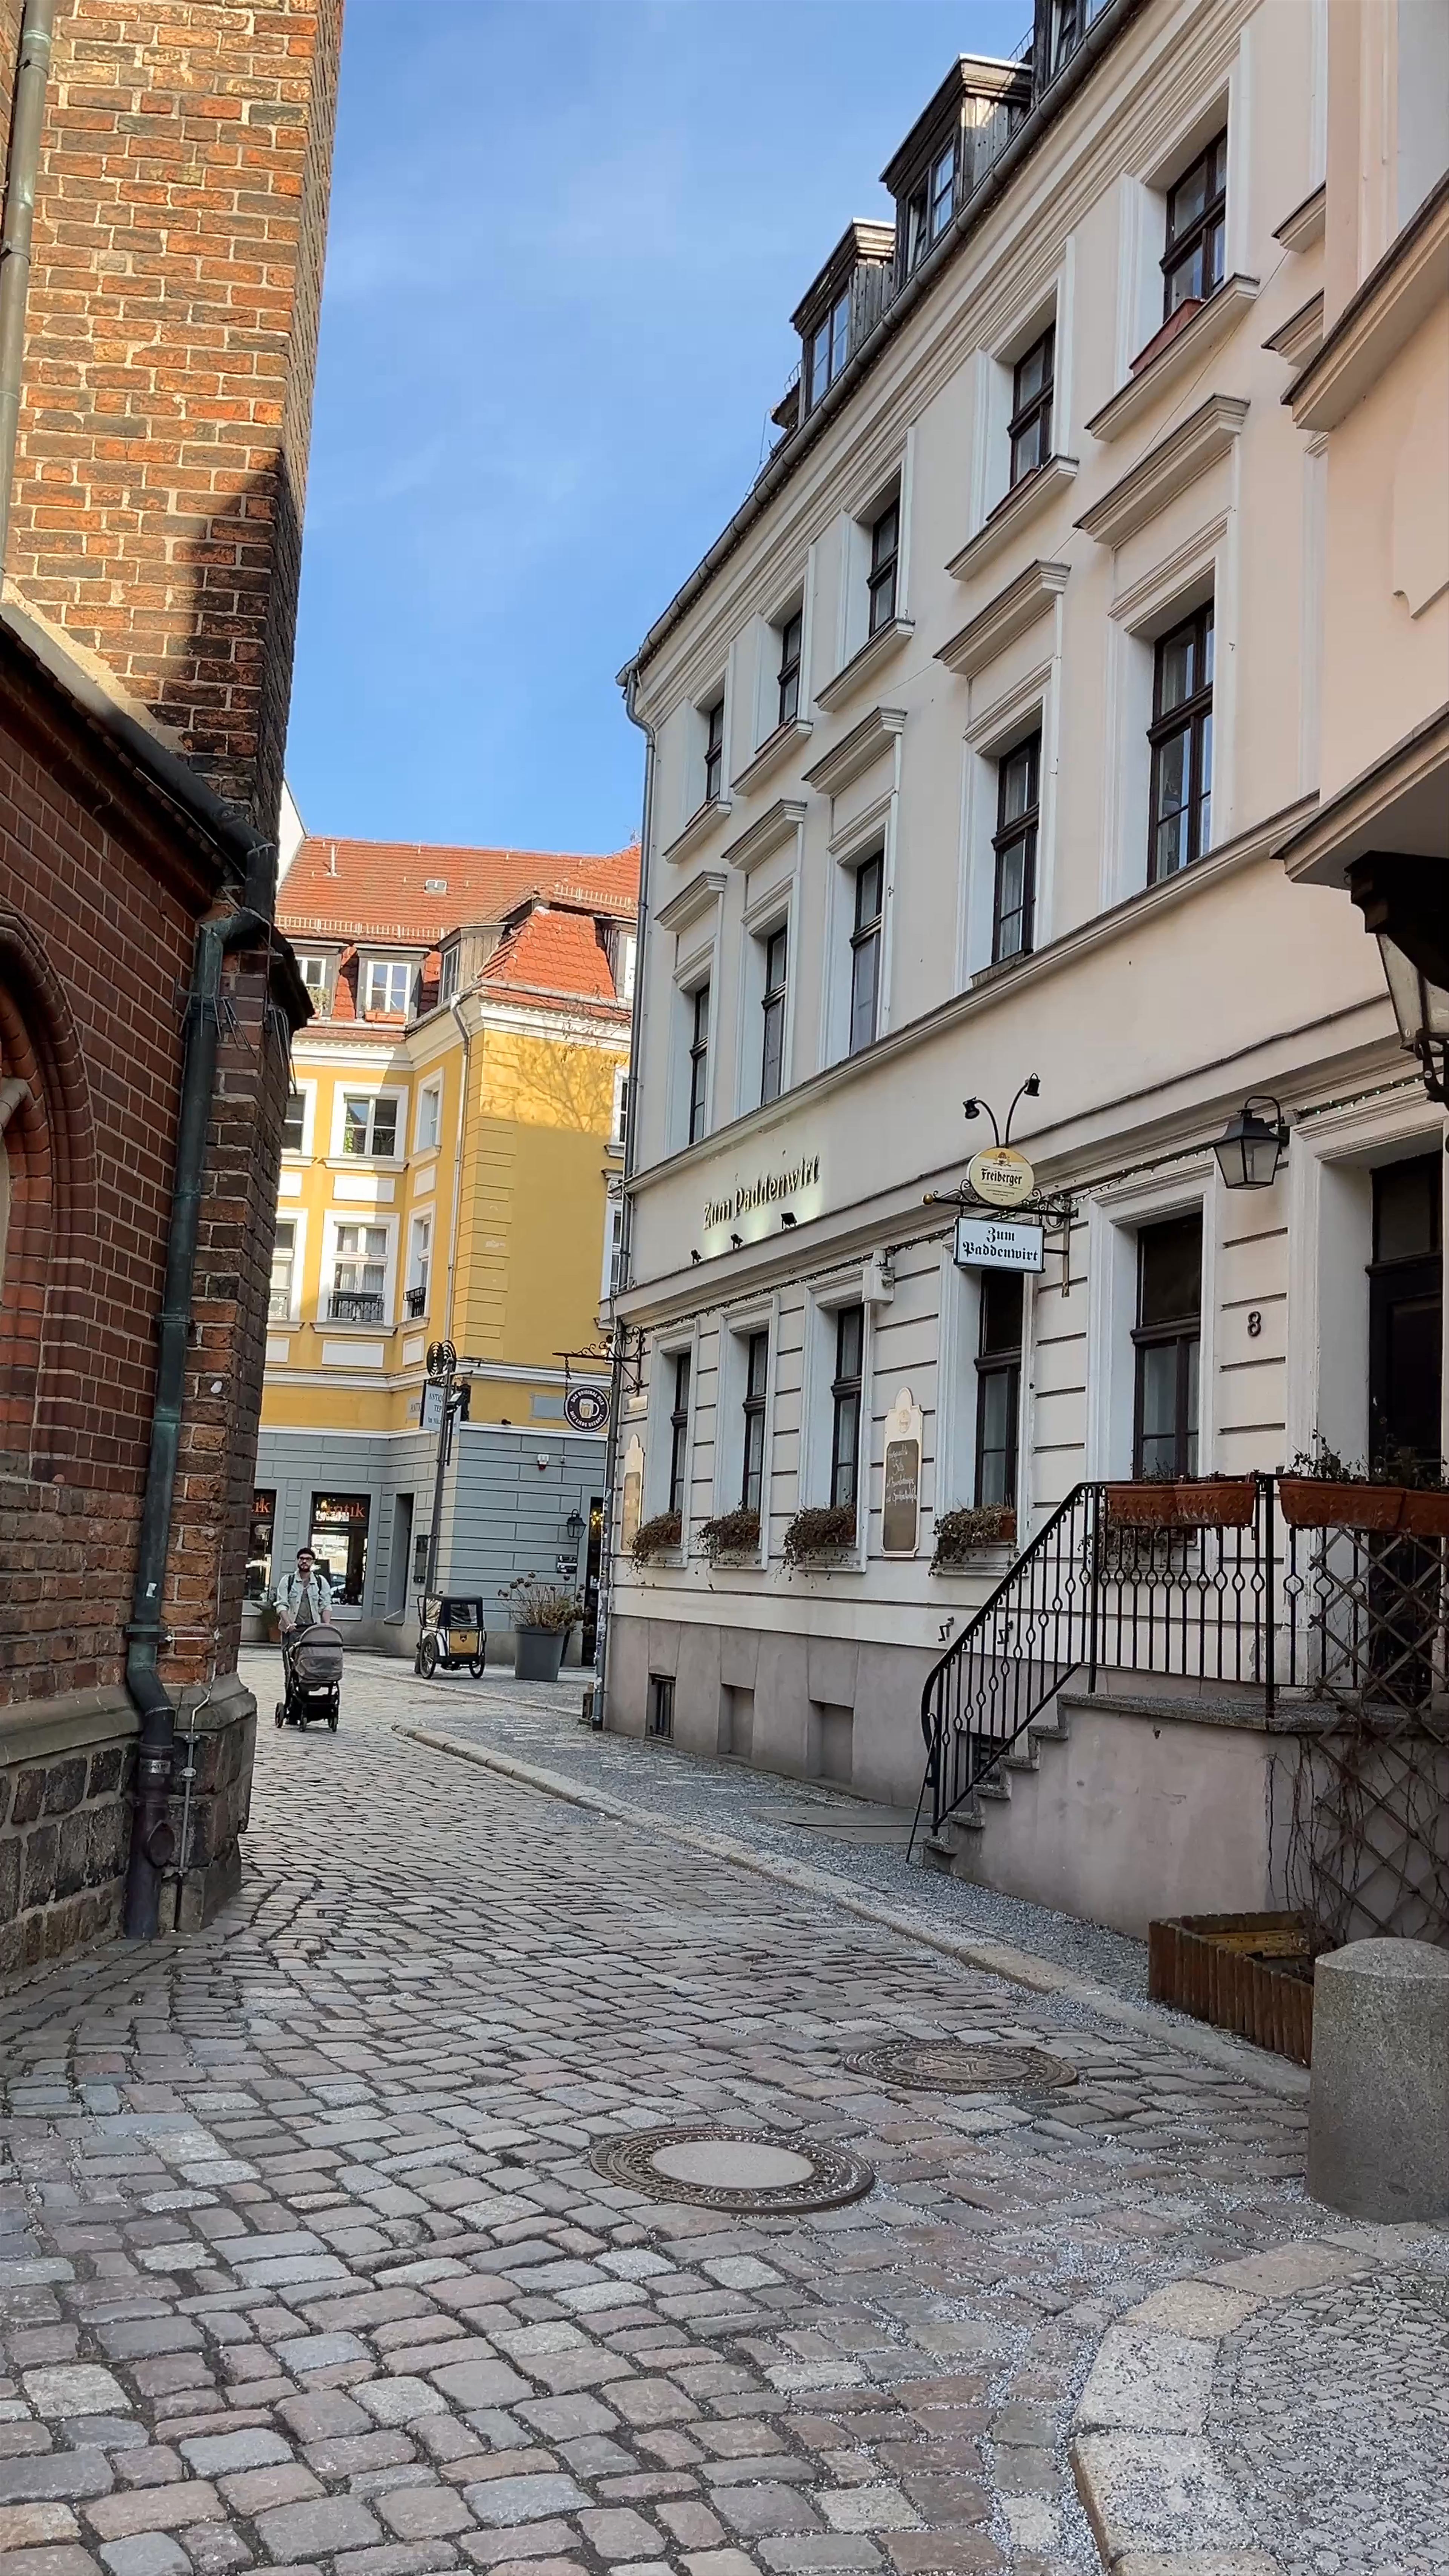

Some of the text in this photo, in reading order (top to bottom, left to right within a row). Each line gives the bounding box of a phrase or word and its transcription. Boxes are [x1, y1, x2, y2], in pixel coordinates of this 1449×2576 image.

[735, 1154, 820, 1218] Paddenwirt
[981, 1168, 1022, 1186] Freiberger
[986, 1227, 1015, 1243] Zum
[963, 1241, 1038, 1261] Paddenwirt
[1247, 1311, 1261, 1337] 8
